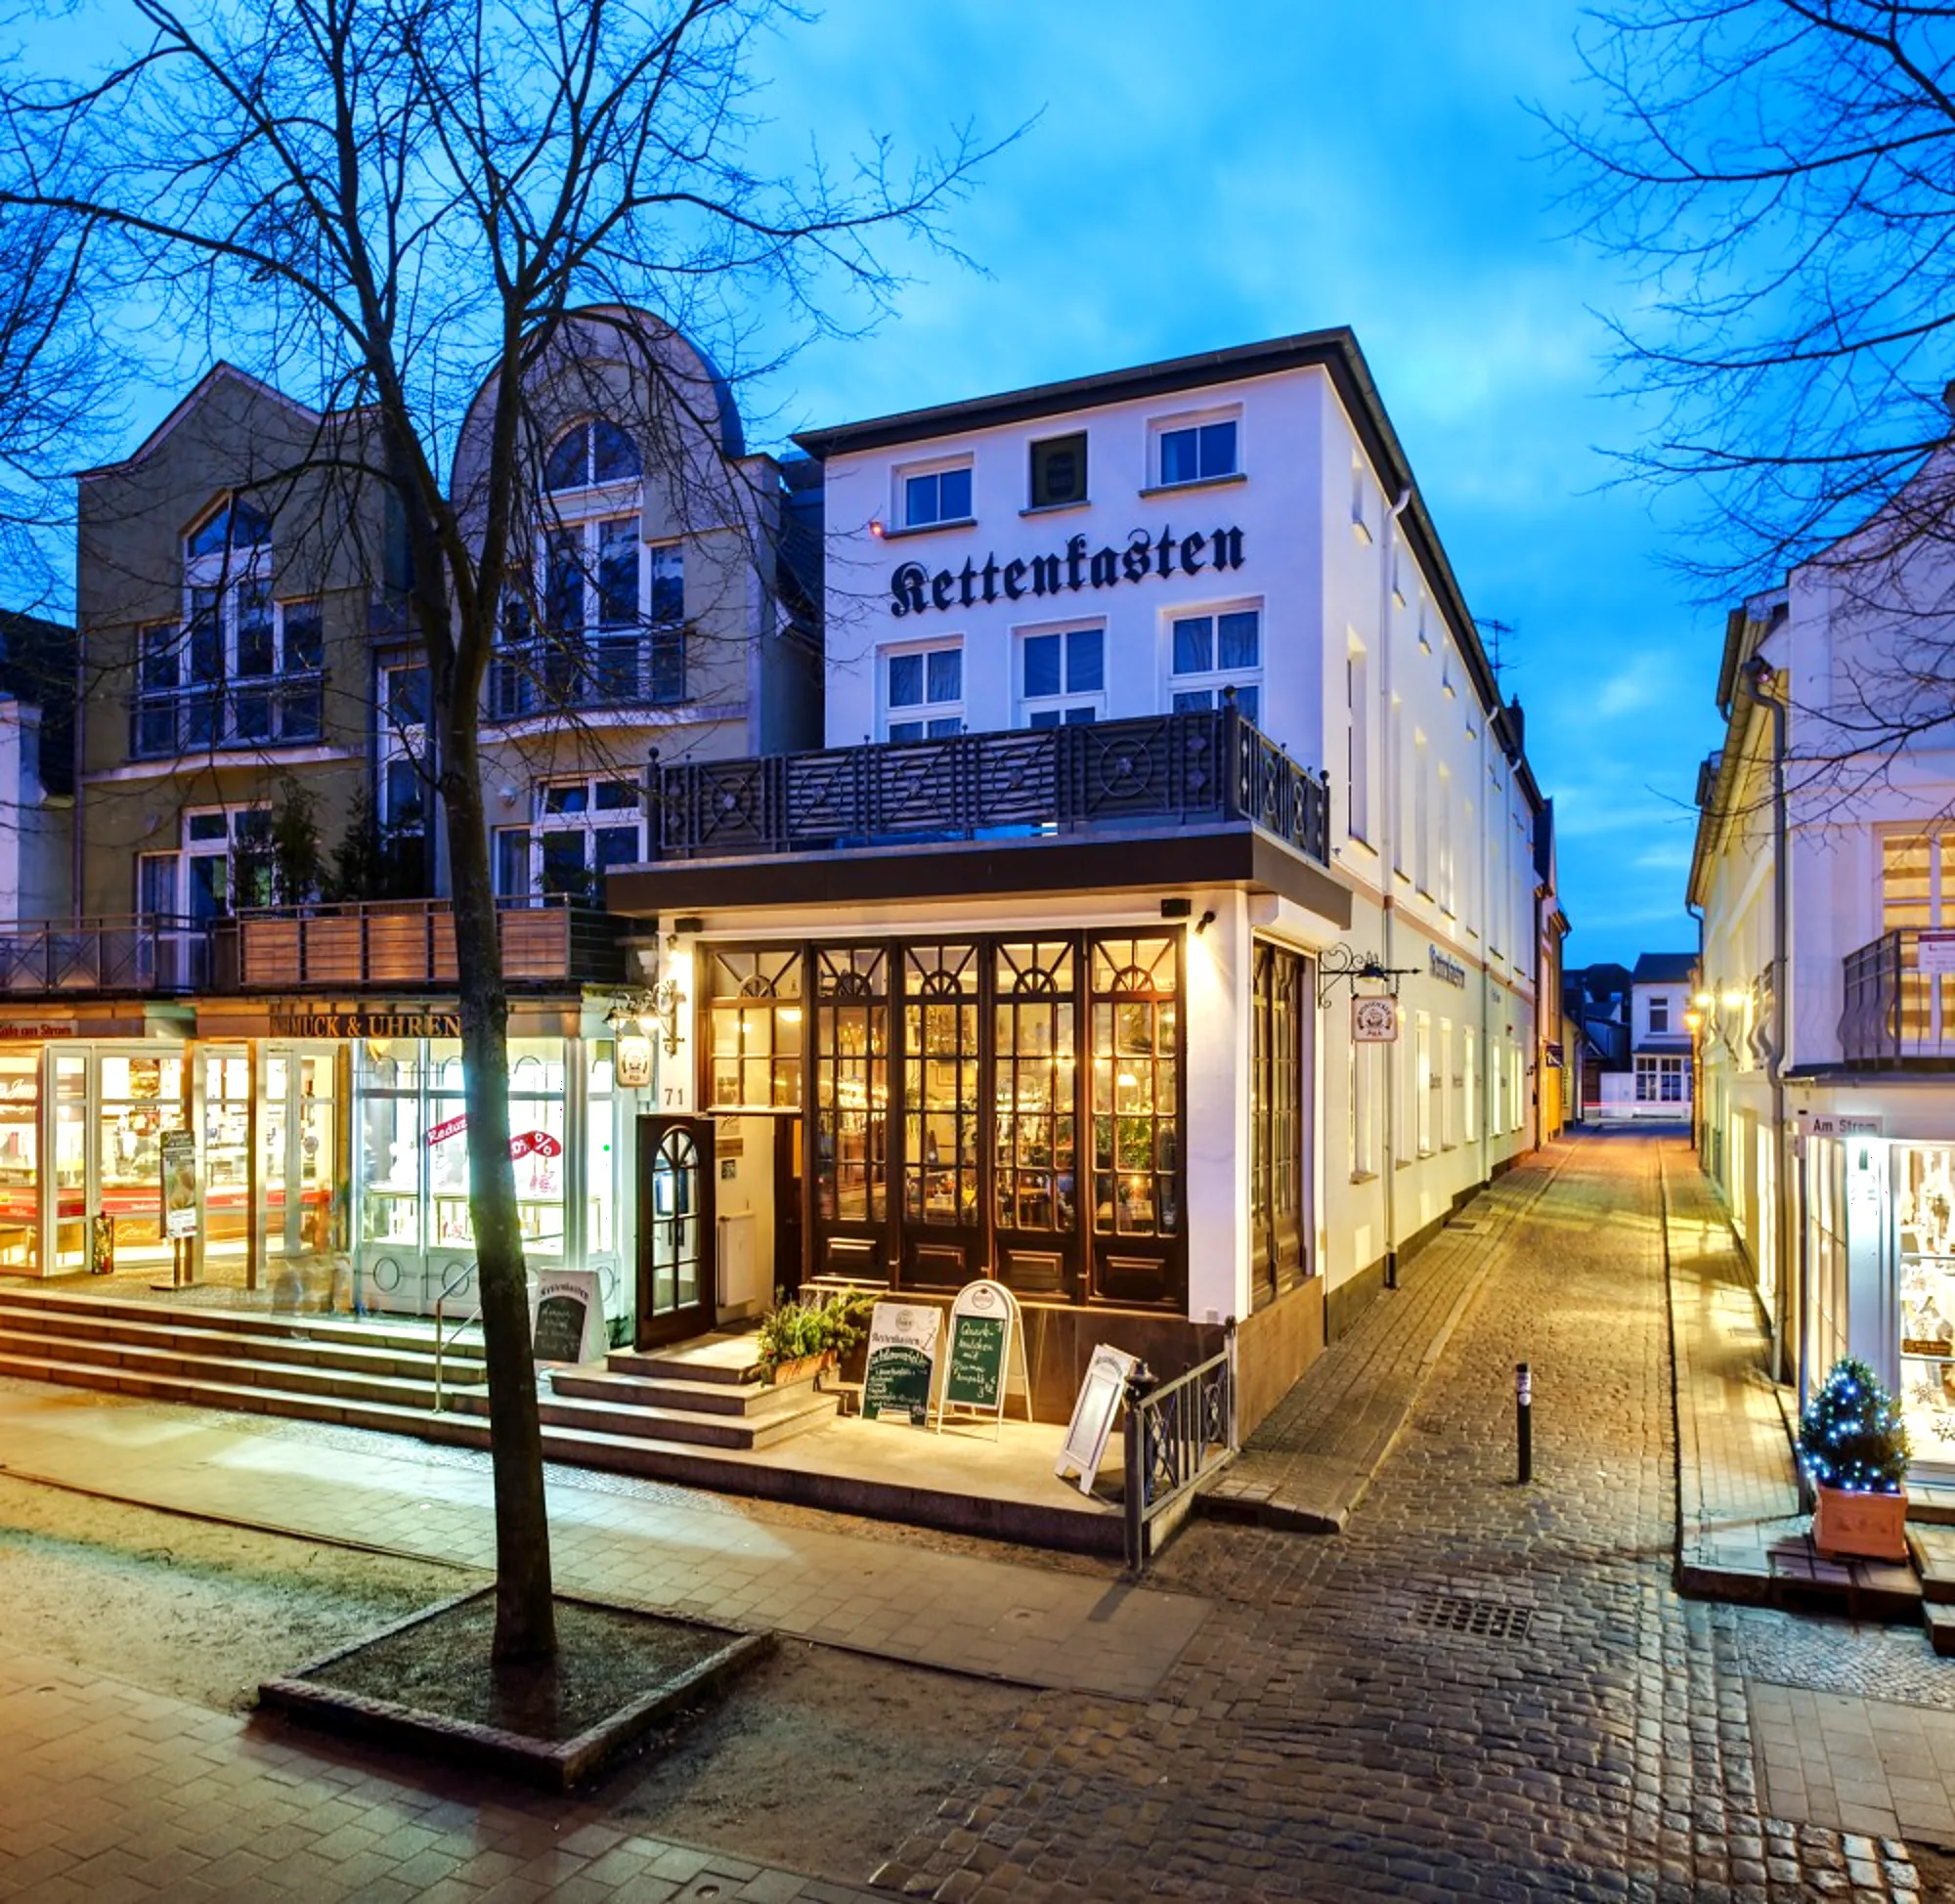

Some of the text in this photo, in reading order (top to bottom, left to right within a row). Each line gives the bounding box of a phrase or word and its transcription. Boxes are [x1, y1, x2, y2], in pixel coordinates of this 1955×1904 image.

[891, 524, 1245, 619] Kettenkasten
[22, 1027, 38, 1036] am
[40, 1023, 71, 1036] Strom
[271, 1015, 461, 1037] MUCK & UHREN
[665, 1088, 683, 1106] 71
[1813, 1118, 1878, 1134] Am Strom
